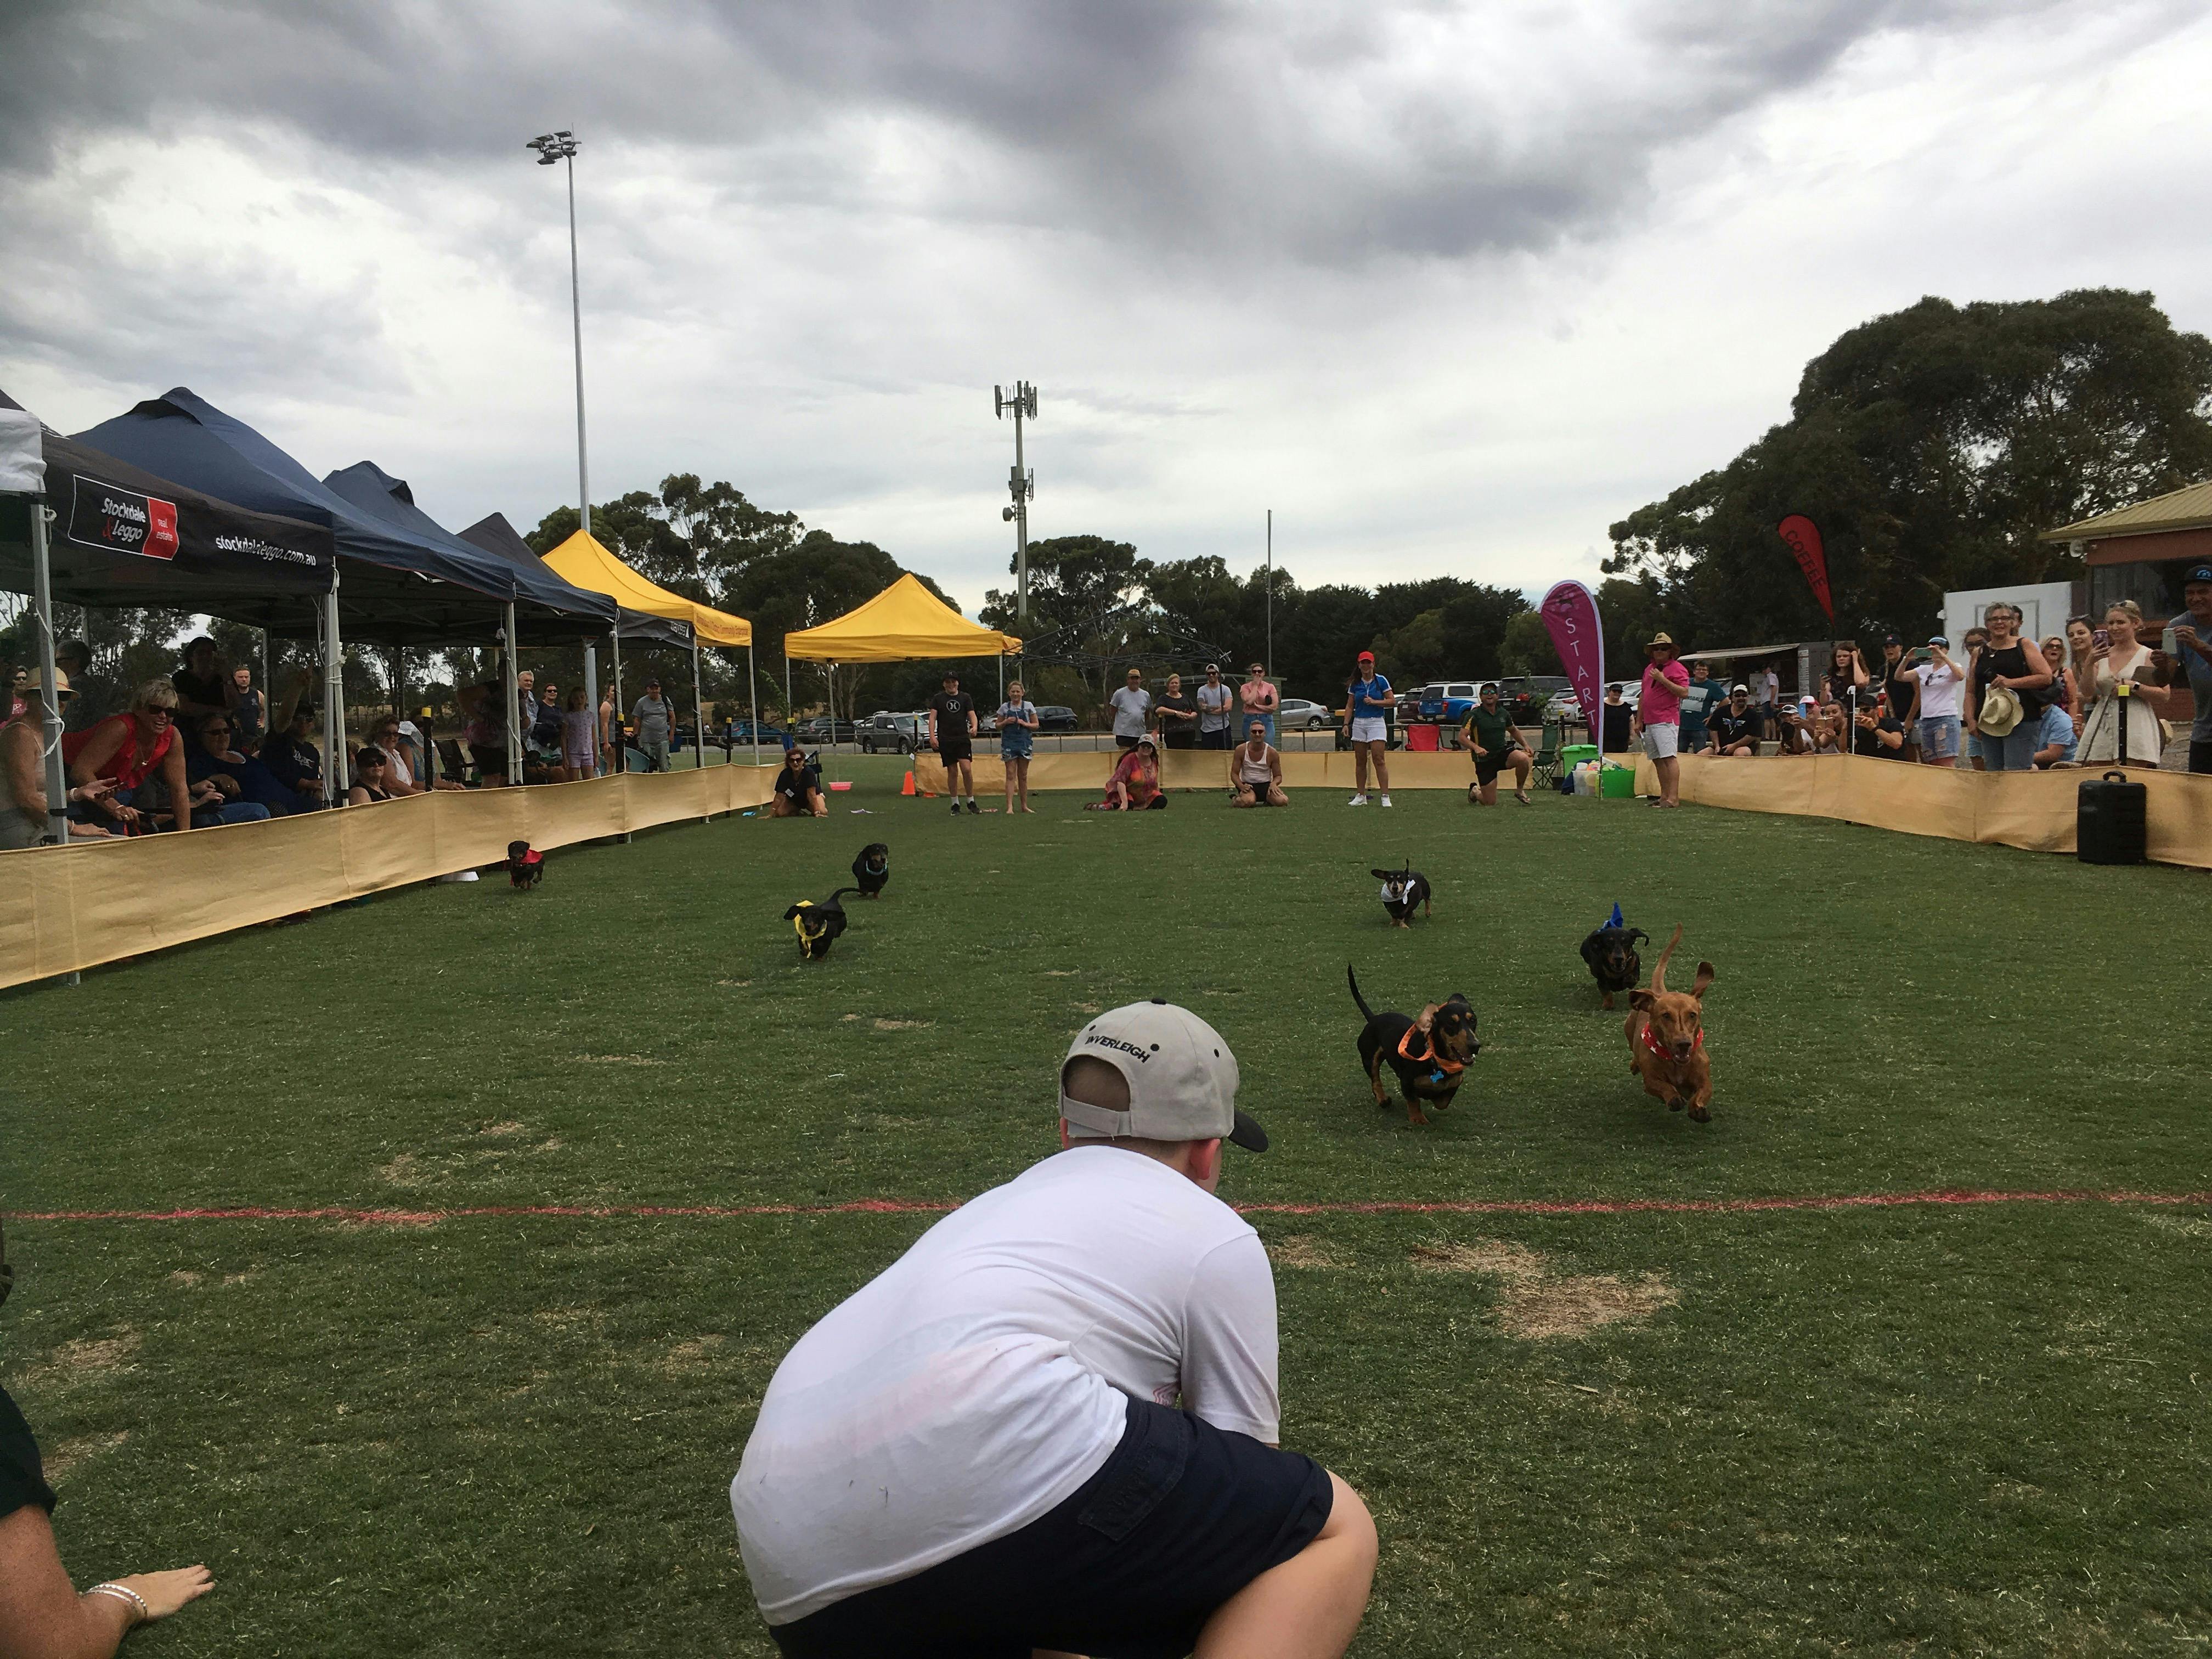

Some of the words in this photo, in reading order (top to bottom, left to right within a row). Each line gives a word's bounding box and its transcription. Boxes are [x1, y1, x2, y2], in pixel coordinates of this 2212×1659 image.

[101, 498, 146, 523] Stockdale
[157, 518, 168, 528] real
[102, 516, 114, 541] &
[112, 520, 143, 543] Leggo
[156, 531, 173, 541] estate
[216, 535, 317, 566] stockdaleleggo.com.au
[1785, 530, 1825, 588] COFFEE
[1565, 617, 1596, 726] START
[1085, 1036, 1150, 1063] INVERLEIGH
